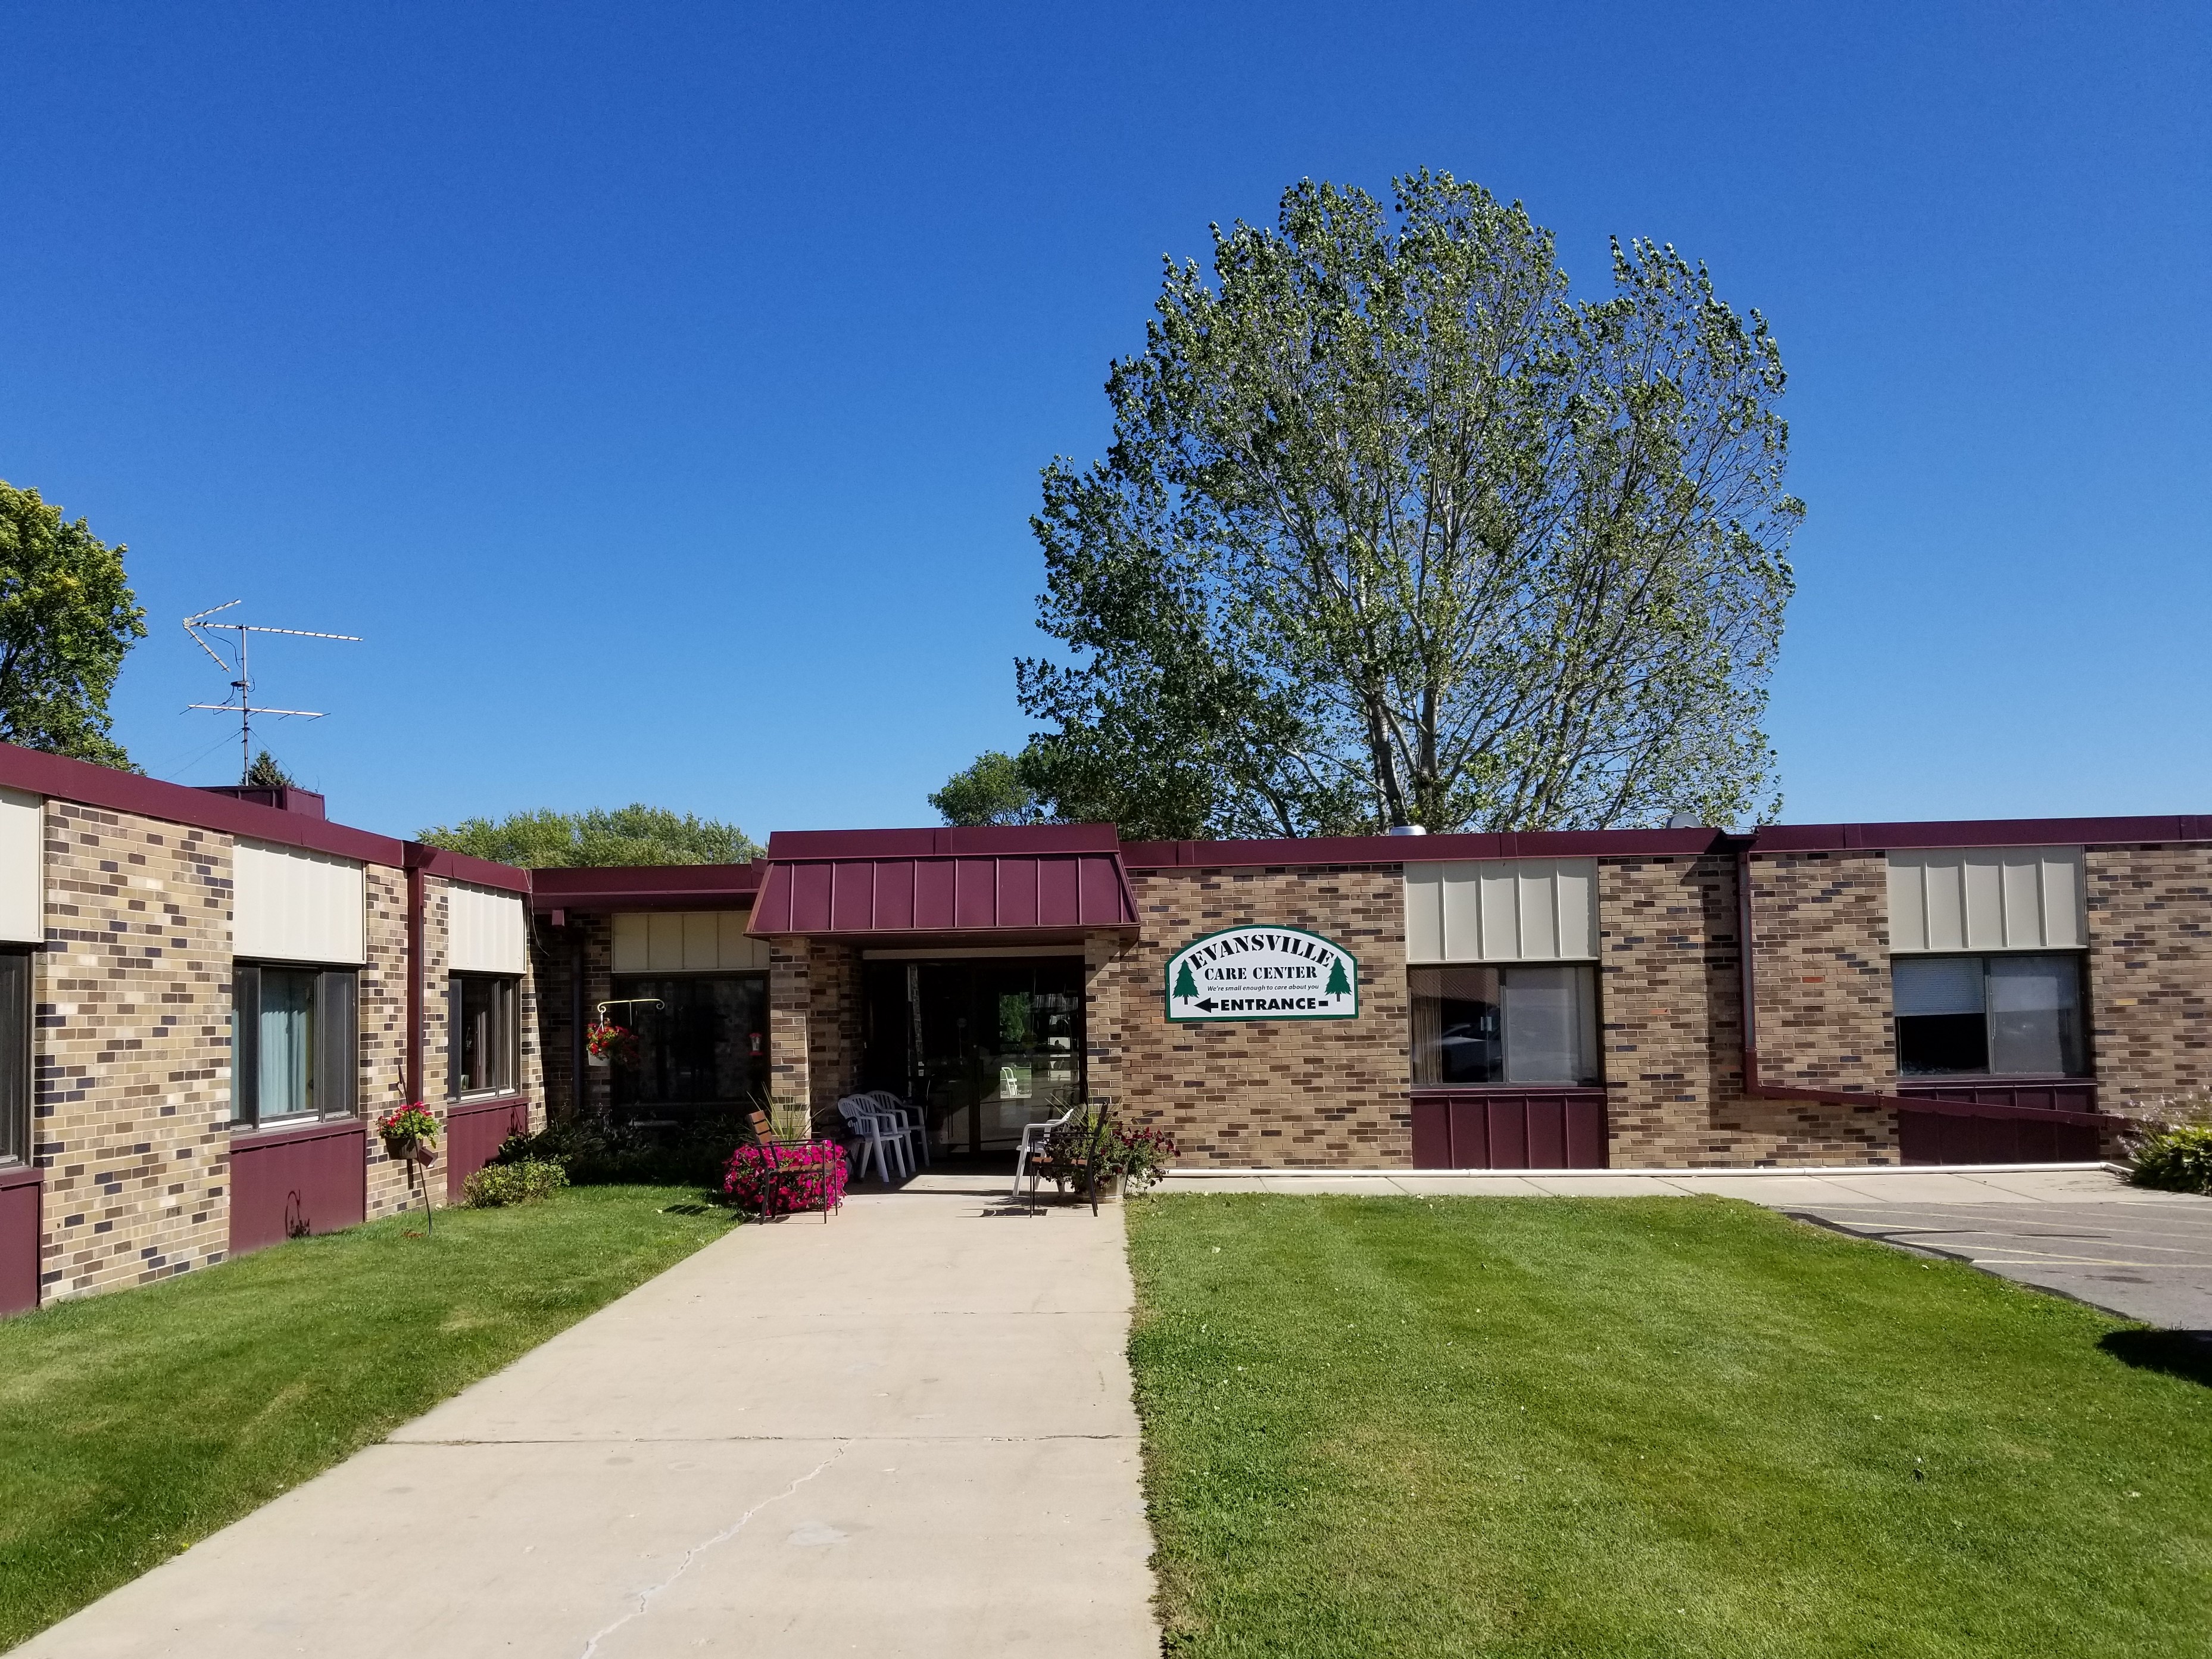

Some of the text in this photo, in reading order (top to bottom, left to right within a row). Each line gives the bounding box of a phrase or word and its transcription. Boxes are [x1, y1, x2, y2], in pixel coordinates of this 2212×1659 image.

[1188, 934, 1335, 971] EVANSVILLE
[1205, 965, 1318, 981] CARE CENTER
[1220, 997, 1316, 1011] ENTRANCE
